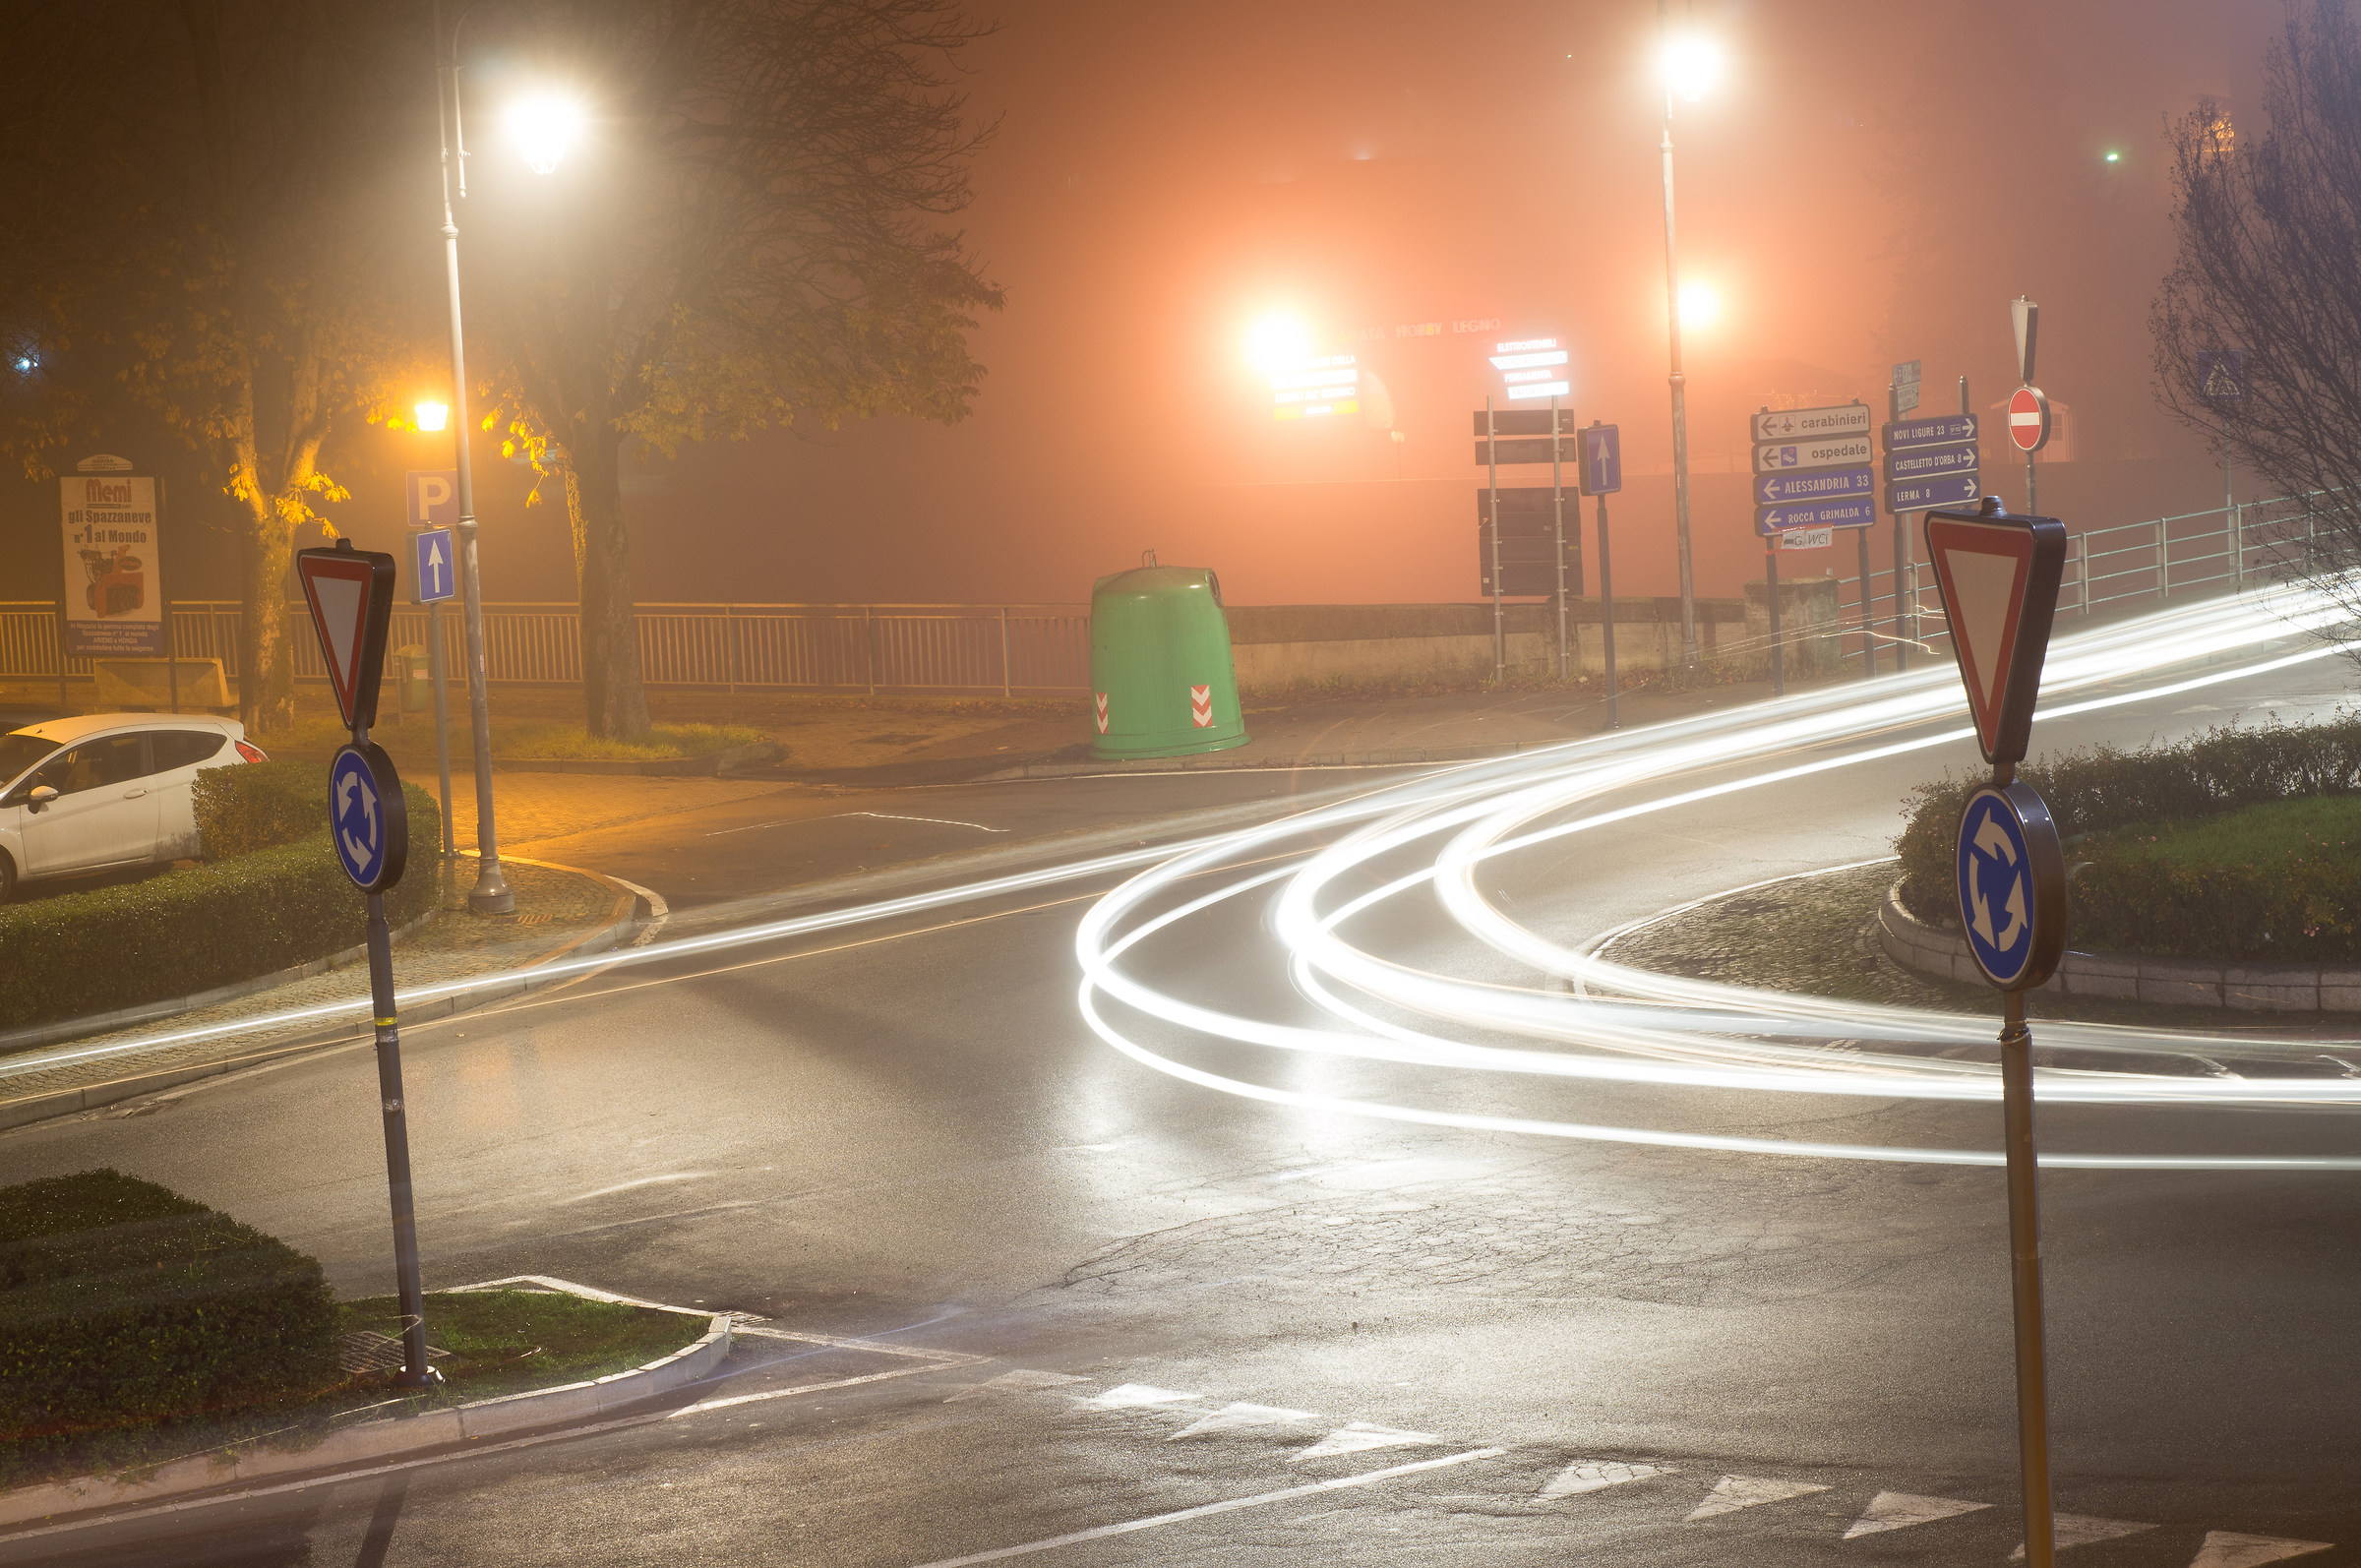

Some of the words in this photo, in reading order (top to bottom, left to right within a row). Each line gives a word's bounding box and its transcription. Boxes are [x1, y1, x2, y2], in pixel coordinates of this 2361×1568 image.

[1395, 322, 1442, 338] HOBBY
[1452, 317, 1501, 333] LEGNO
[1801, 412, 1866, 429] carabinieri
[1894, 429, 1909, 441] NOVI
[1911, 426, 1934, 438] LIGURE
[1936, 425, 1945, 435] 23
[1811, 444, 1867, 459] ospedale
[1895, 457, 1933, 471] CASTELLETTO
[1934, 454, 1956, 466] D'ORBA
[1957, 453, 1962, 463] 8
[86, 478, 132, 503] Memi
[1785, 476, 1849, 494] ALESSANDRIA
[1856, 474, 1869, 487] 33
[418, 476, 452, 520] P
[1897, 490, 1920, 502] LERMA
[1925, 488, 1931, 498] 8
[68, 510, 83, 524] gli
[86, 510, 151, 524] Spazzaneve
[1788, 512, 1815, 523] ROCCA
[1820, 507, 1859, 520] GRIMALDA
[1864, 506, 1870, 516] 6
[94, 529, 106, 543] al
[108, 529, 147, 543] Mondo
